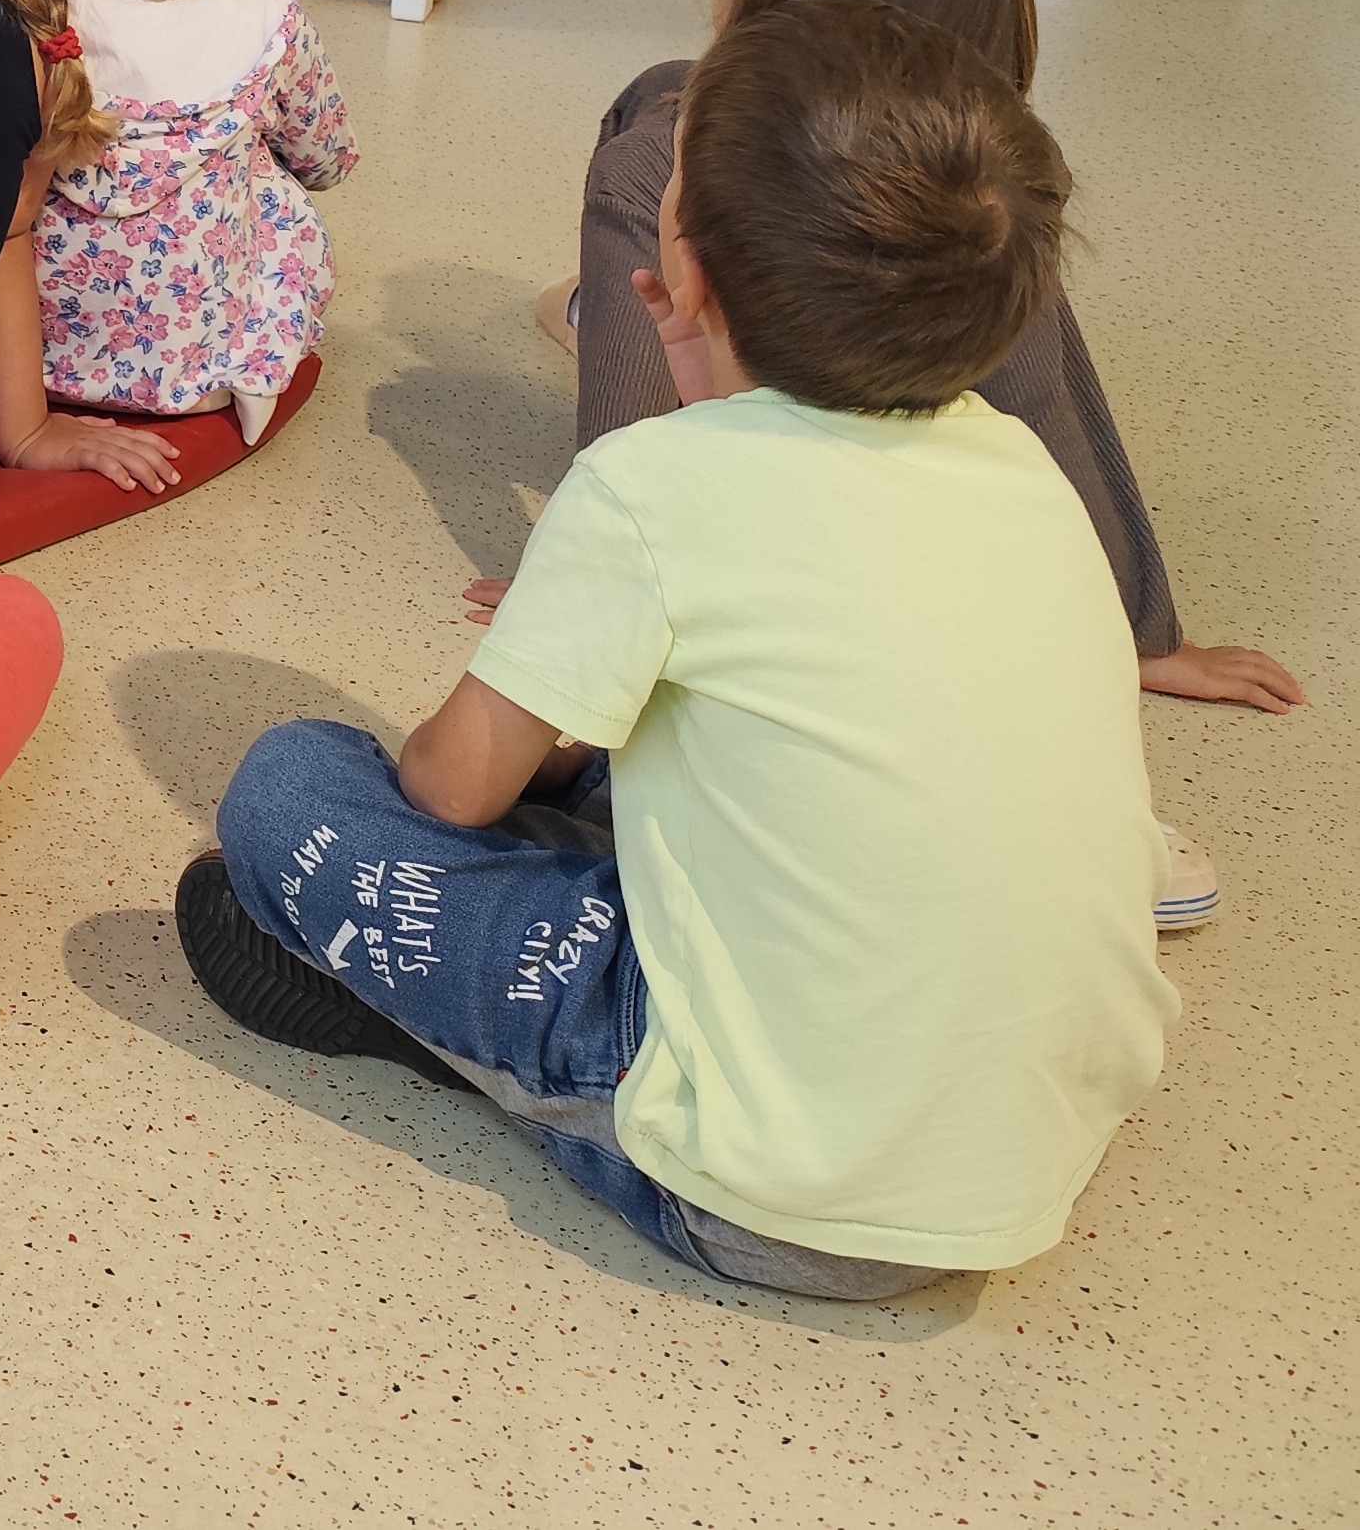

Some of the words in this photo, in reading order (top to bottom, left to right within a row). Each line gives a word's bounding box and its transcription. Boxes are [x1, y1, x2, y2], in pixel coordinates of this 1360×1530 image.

[292, 824, 340, 876] WAY
[280, 871, 302, 896] TO
[350, 860, 386, 908] THE
[389, 861, 447, 977] WHAT'S
[544, 896, 616, 985] CRAZY
[362, 926, 396, 989] BEST
